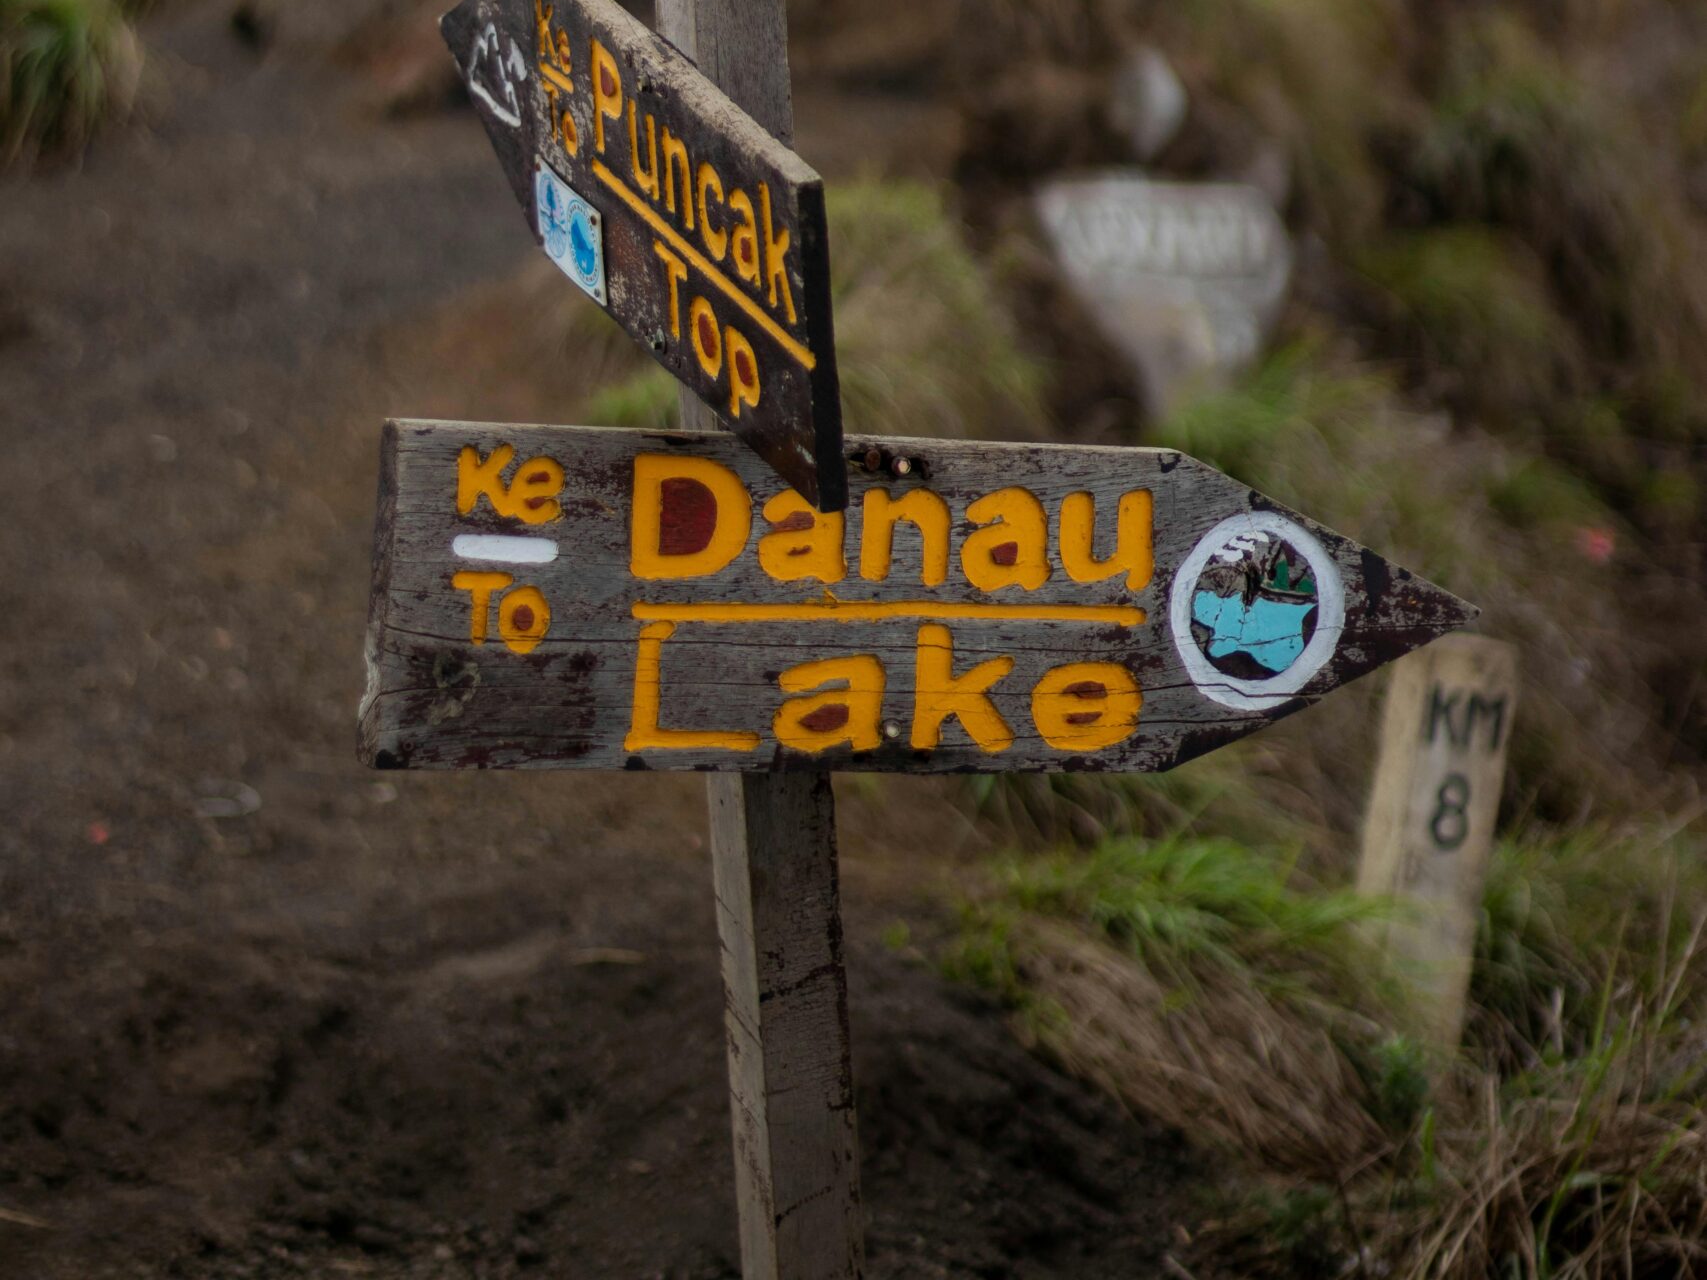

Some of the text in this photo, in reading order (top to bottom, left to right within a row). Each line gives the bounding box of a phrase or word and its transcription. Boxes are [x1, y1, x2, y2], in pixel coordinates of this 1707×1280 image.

[591, 37, 796, 324] Puncak
[457, 443, 565, 524] Ke
[629, 452, 1155, 592] Danau
[624, 620, 1144, 753] Lake
[1424, 680, 1508, 754] KM
[1429, 772, 1470, 852] 8
